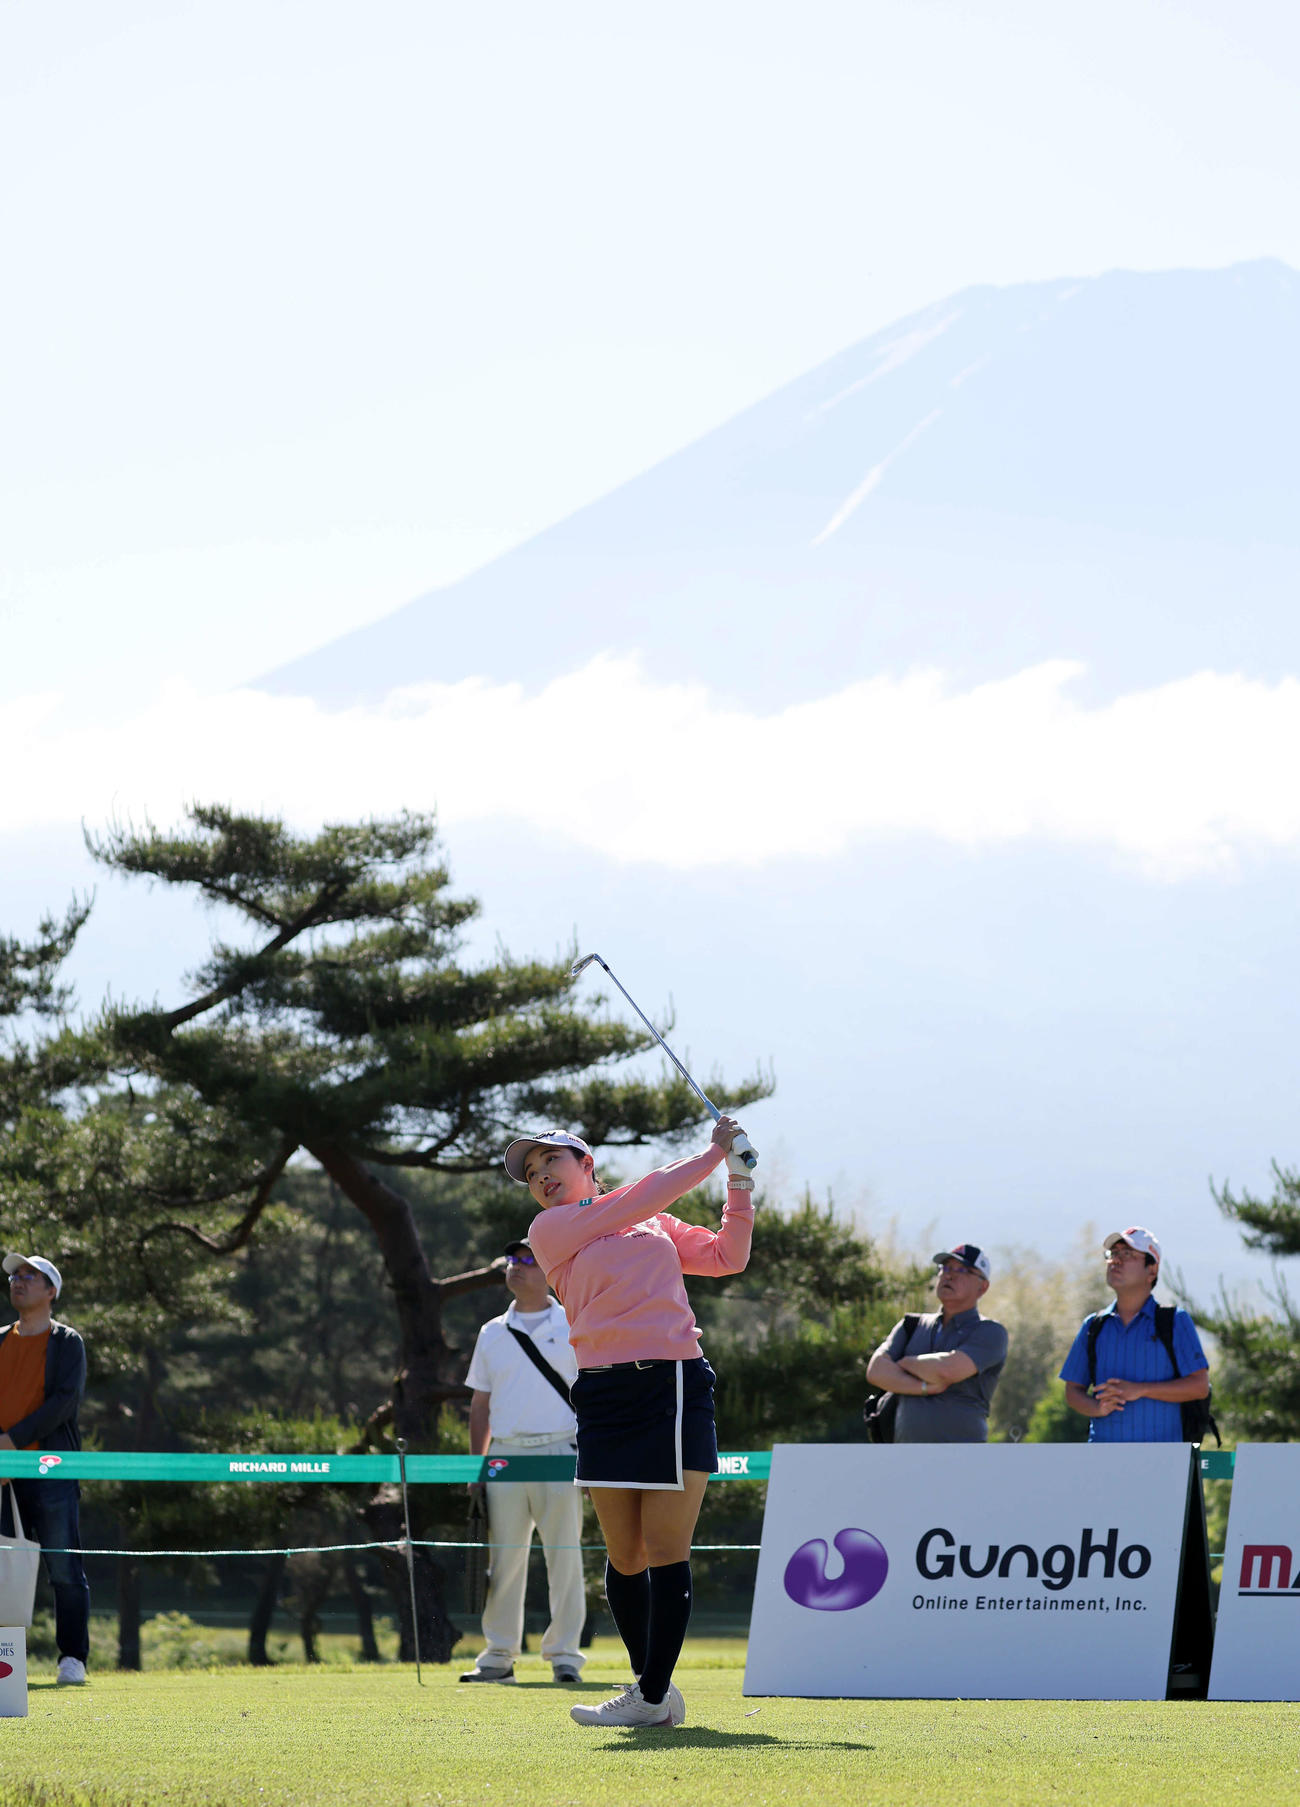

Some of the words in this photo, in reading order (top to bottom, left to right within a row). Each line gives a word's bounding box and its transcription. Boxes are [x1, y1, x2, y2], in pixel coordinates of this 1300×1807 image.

[229, 1462, 287, 1473] RICHARD
[290, 1462, 330, 1473] MILLE
[915, 1527, 1152, 1591] GungHo
[912, 1595, 969, 1610] Online
[975, 1596, 1110, 1614] Entertainment,
[1115, 1597, 1147, 1611] Inc.
